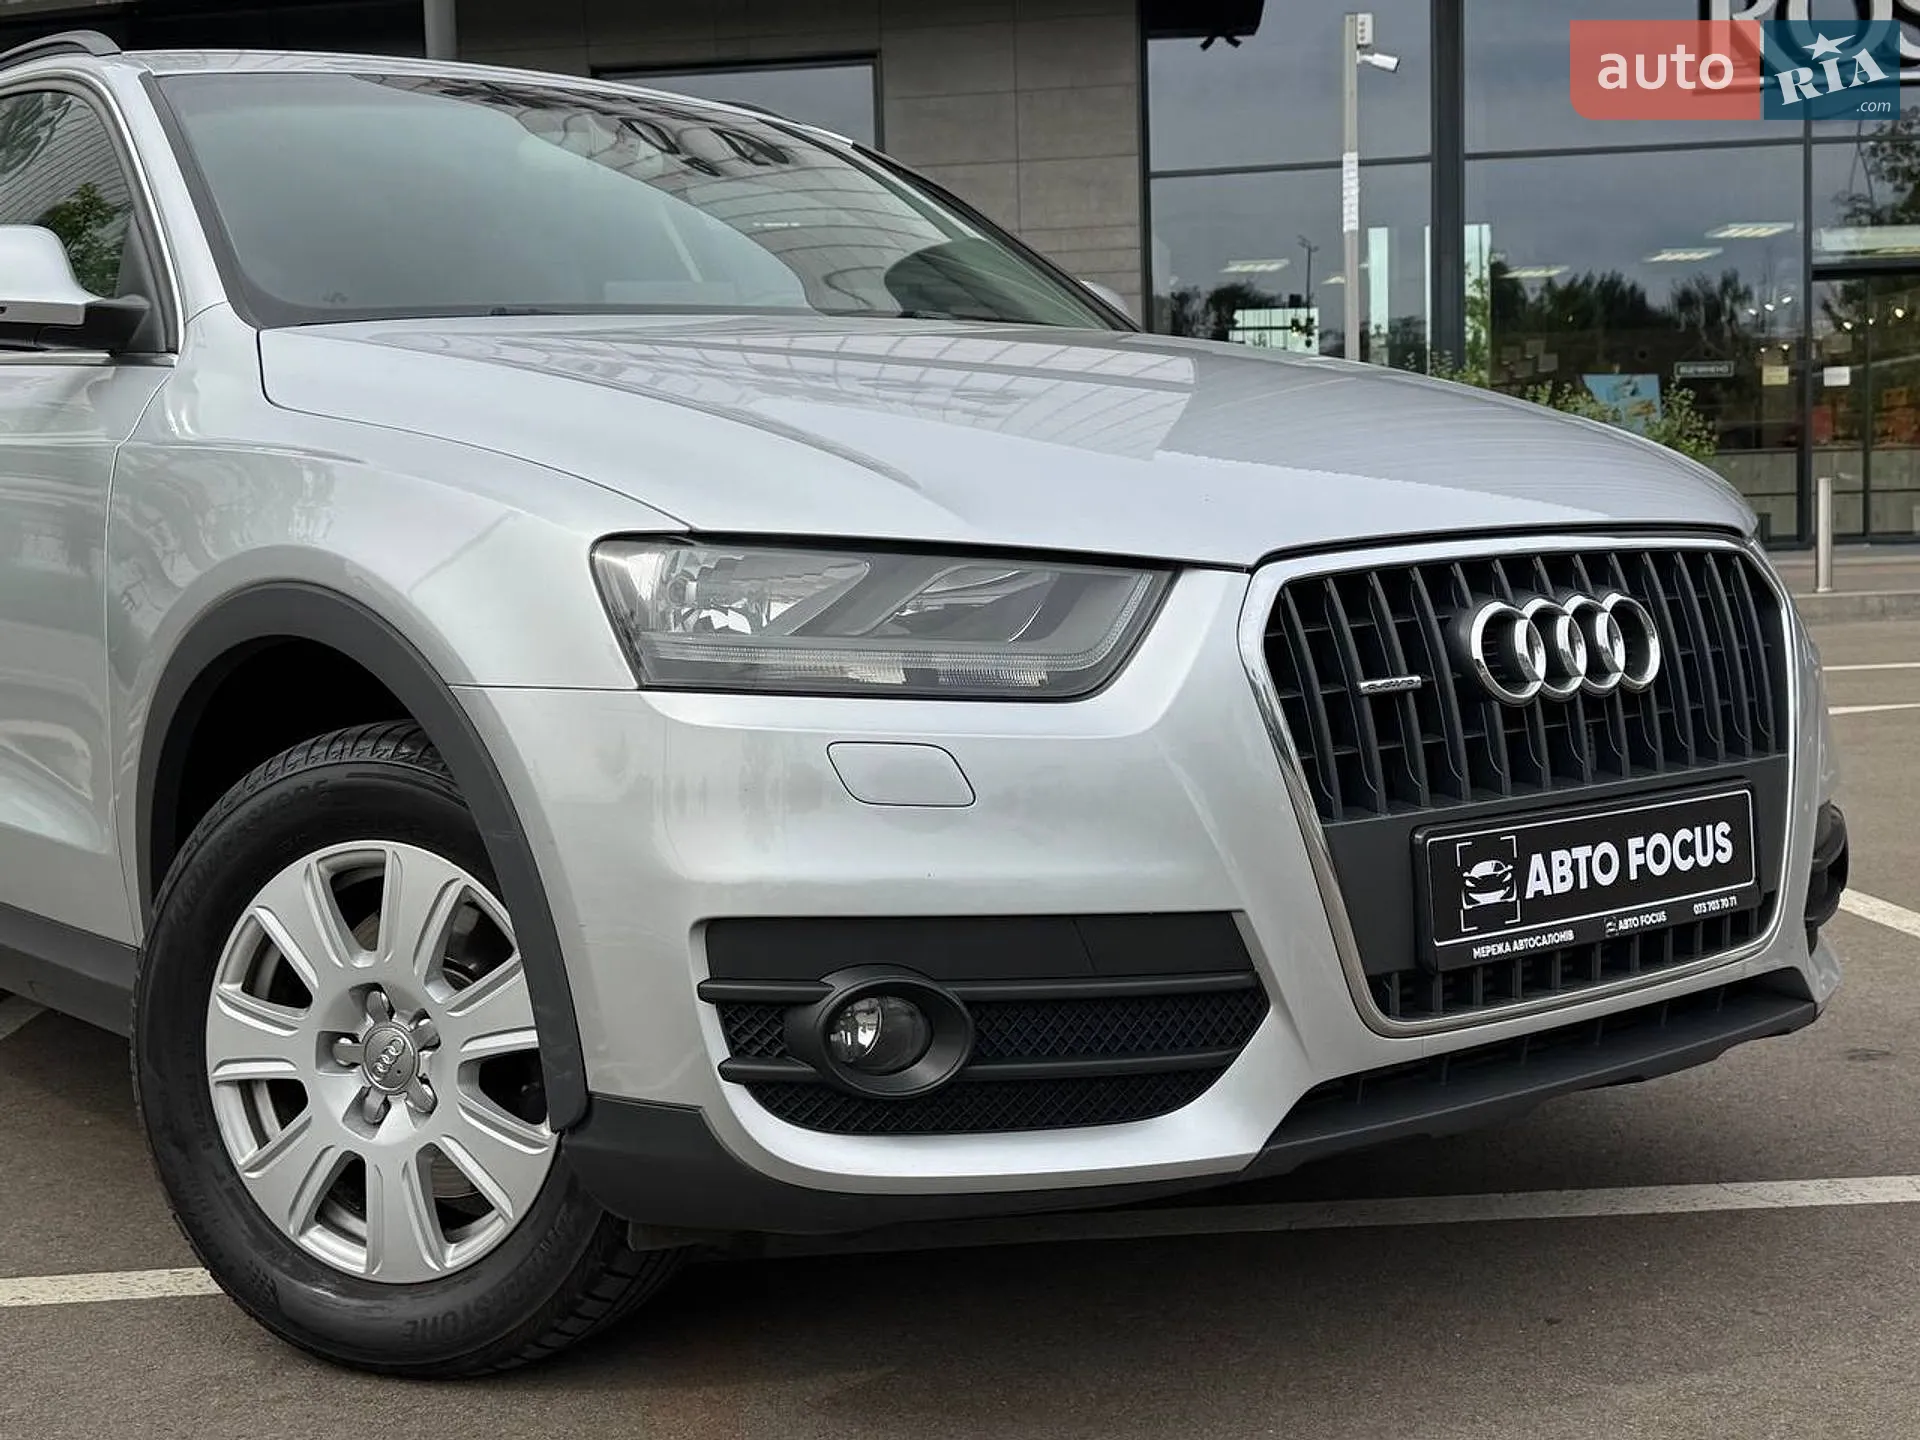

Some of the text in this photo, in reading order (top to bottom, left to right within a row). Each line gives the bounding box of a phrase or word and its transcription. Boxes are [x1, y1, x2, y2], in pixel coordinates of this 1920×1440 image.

[1525, 821, 1734, 900] АВТО FOCUS
[1618, 910, 1667, 931] АВТО FOCUS
[1472, 929, 1575, 960] МЕРЕЖА АВТОСАЛОНІВ
